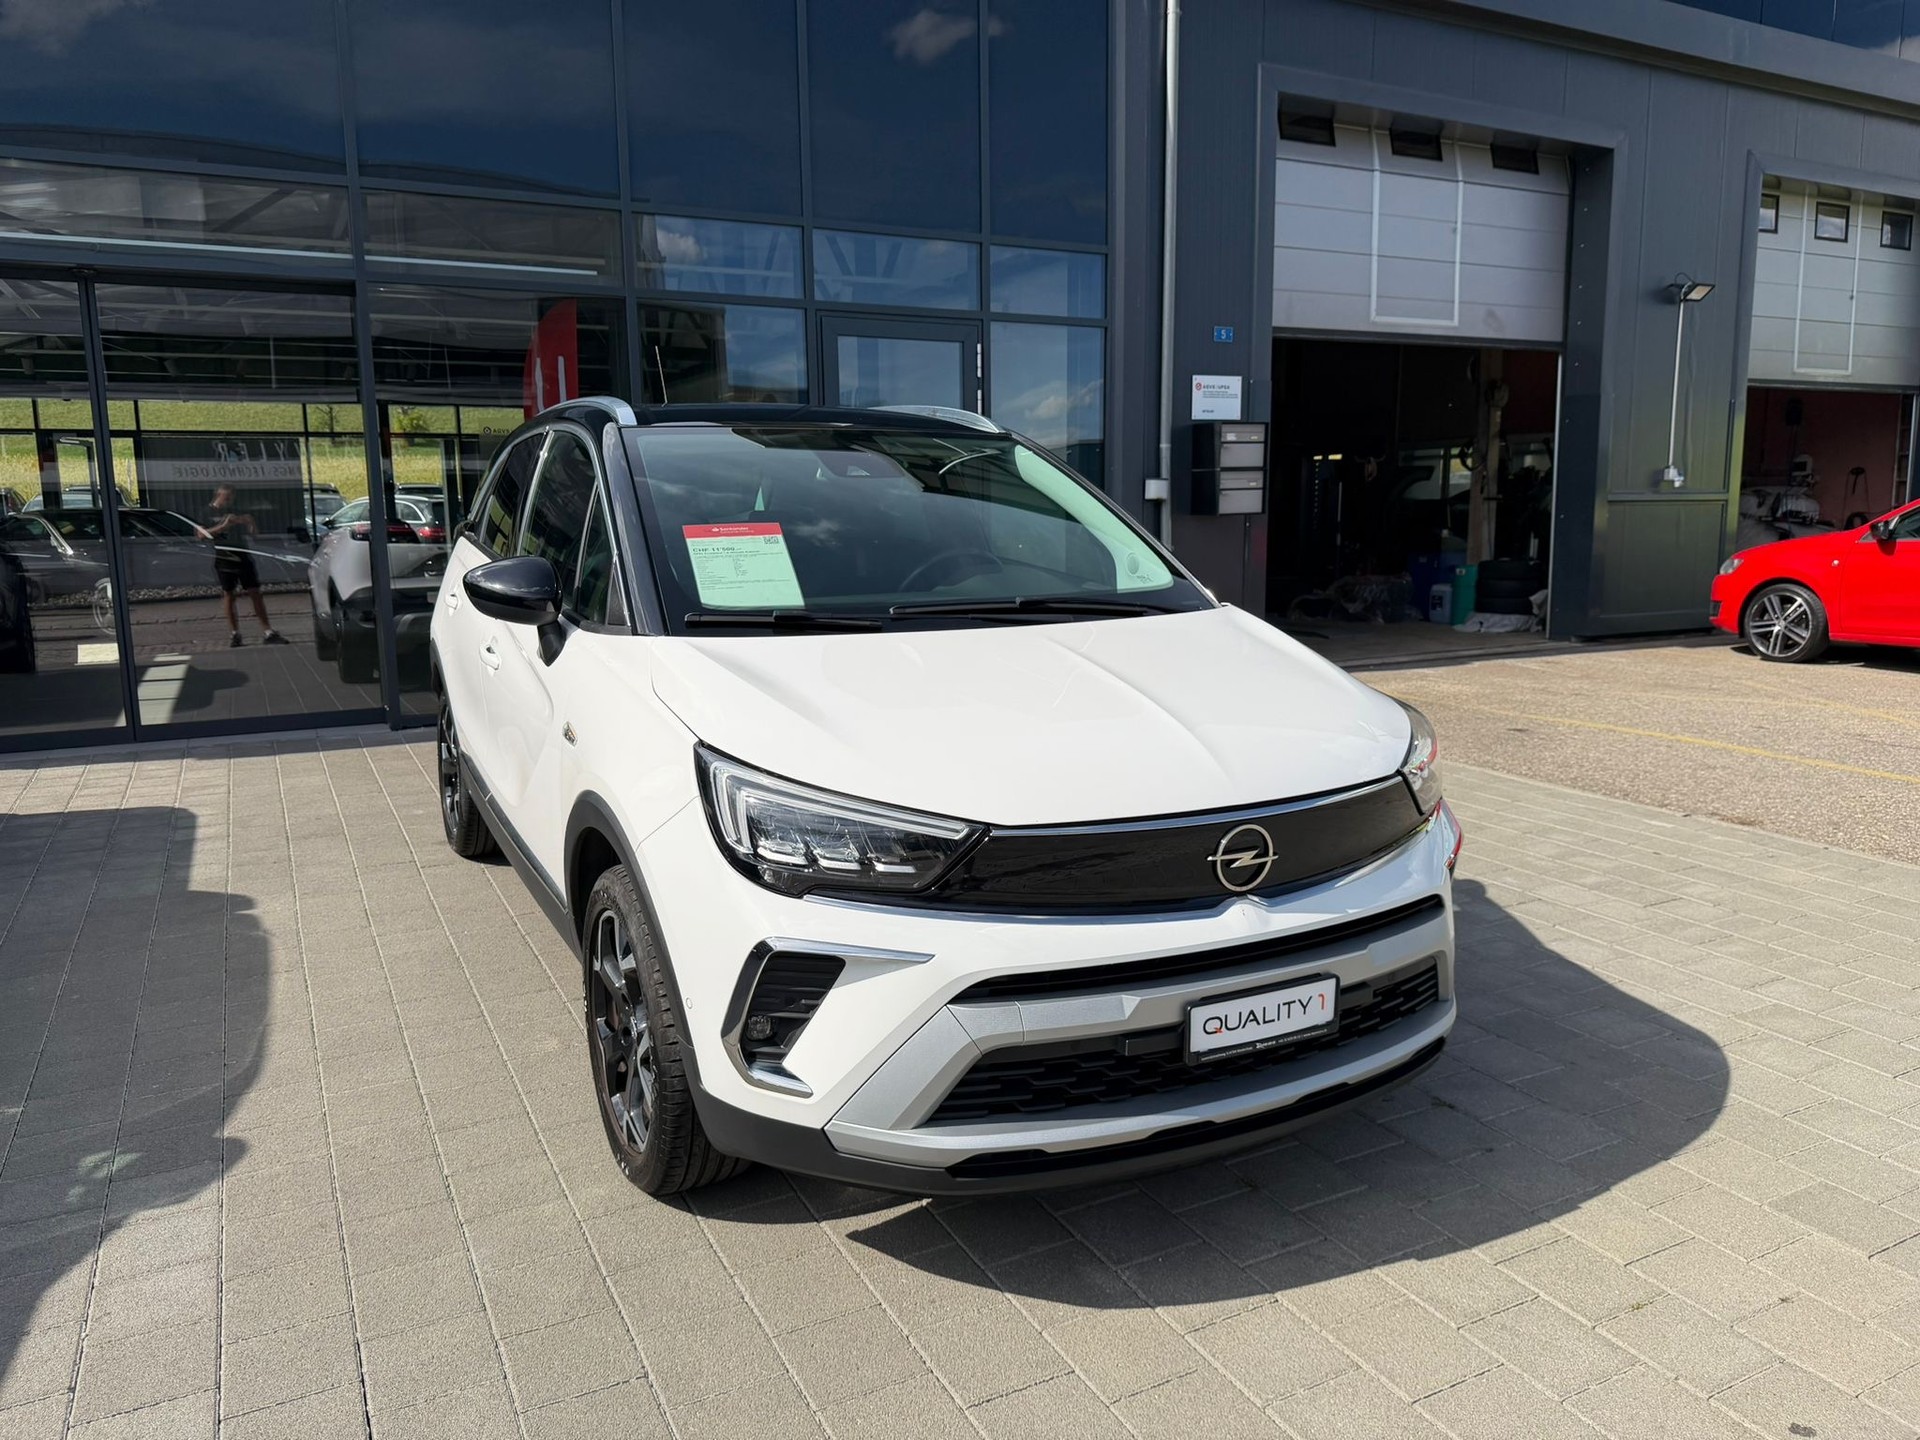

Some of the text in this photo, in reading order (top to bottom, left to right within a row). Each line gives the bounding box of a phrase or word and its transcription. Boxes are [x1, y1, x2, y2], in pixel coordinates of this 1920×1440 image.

[1221, 329, 1226, 339] 5
[1203, 992, 1326, 1035] QUALITY 1
